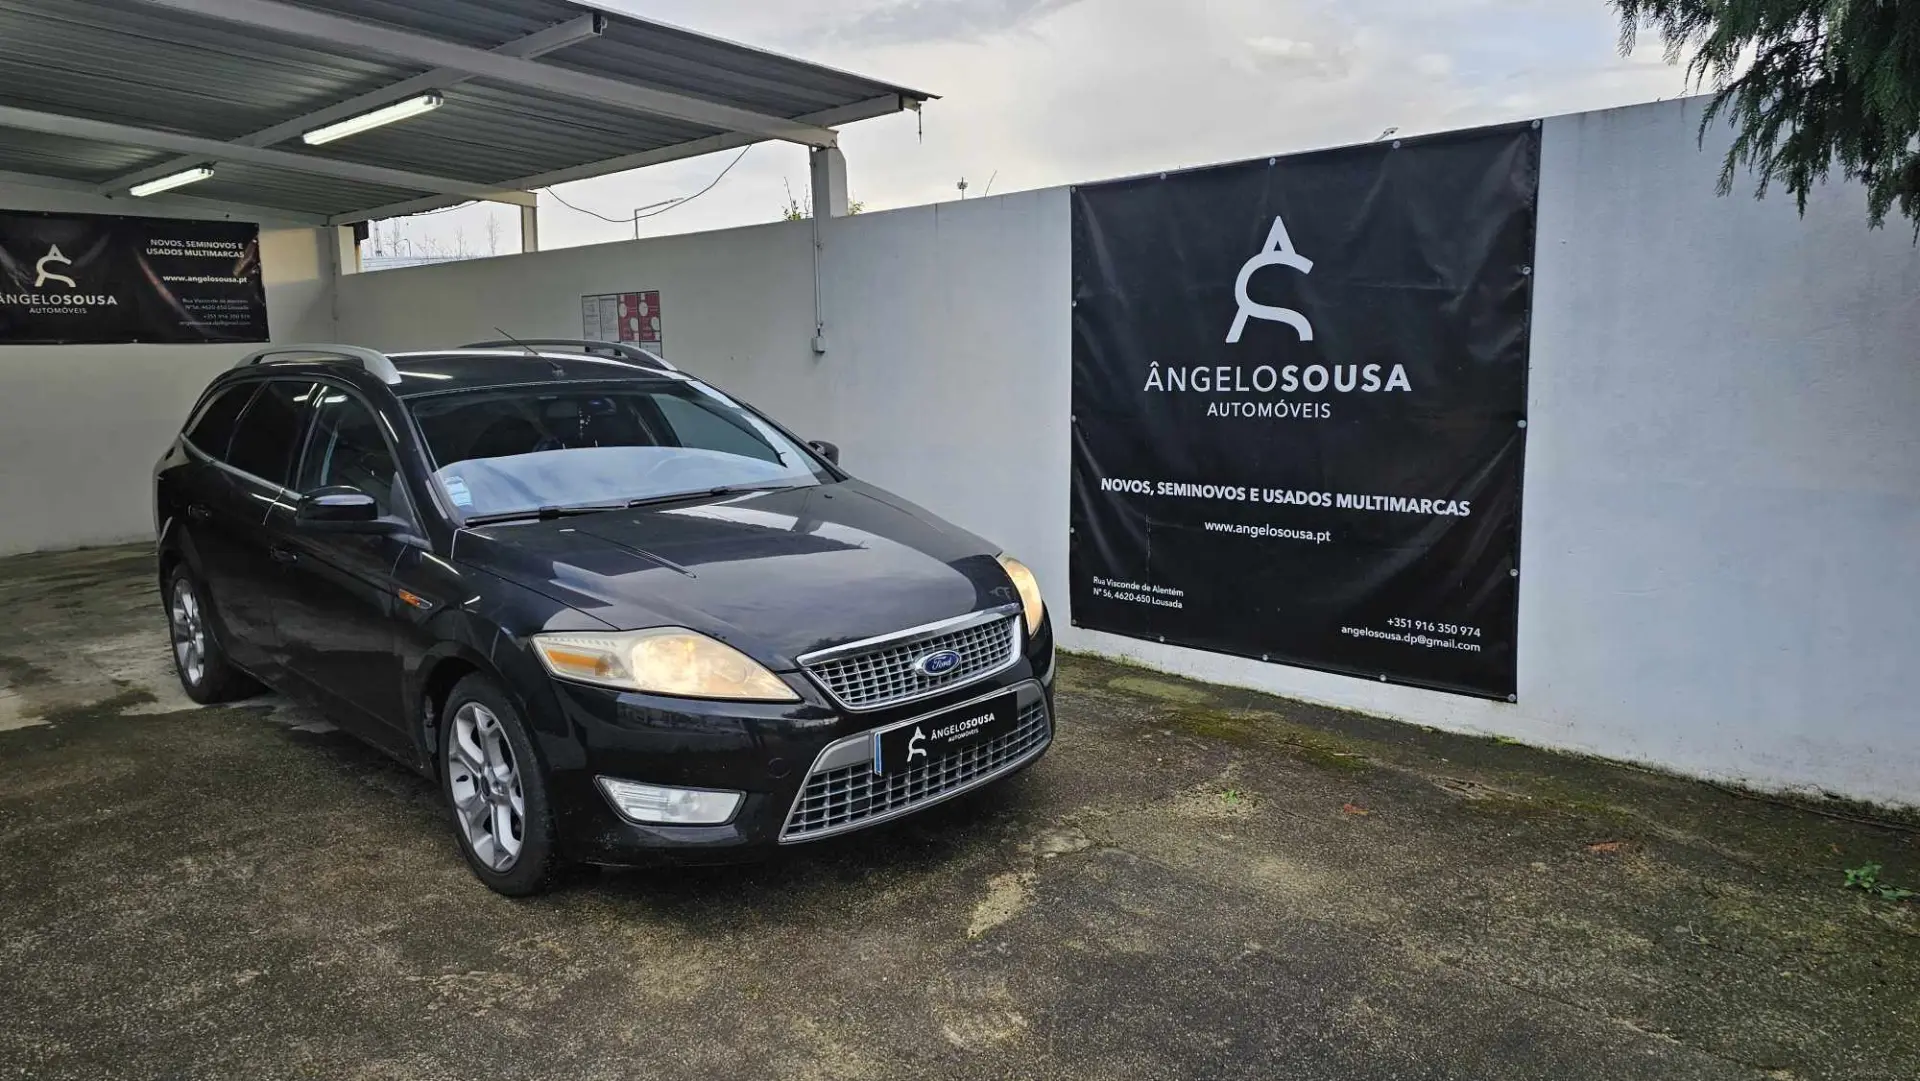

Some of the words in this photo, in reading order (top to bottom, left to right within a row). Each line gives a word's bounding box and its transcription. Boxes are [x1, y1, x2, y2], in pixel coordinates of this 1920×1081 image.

[146, 248, 183, 256] USADOS
[184, 249, 245, 258] MULTIMARCAS
[150, 239, 185, 248] NOVOS,
[186, 241, 237, 249] SEMINOVOS
[163, 275, 247, 284] www.angelosousa.pt
[29, 306, 88, 314] AUTOMÓVEIS
[1144, 361, 1412, 393] ÂNGELOSOUSA
[1207, 399, 1331, 418] AUTOMÓVEIS
[1101, 478, 1154, 496] NOVOS,
[1157, 482, 1246, 500] SEMINOVOS
[1250, 488, 1259, 501] E
[1263, 489, 1332, 507] USADOS
[1336, 493, 1471, 517] MULTIMARCAS
[1204, 521, 1331, 544] www.angelosousa.pt
[1093, 576, 1106, 585] Rua
[1106, 579, 1140, 590] Visconde
[1141, 583, 1151, 592] de
[1103, 590, 1114, 599] 56,
[1114, 593, 1151, 604] 4620-650
[1152, 597, 1183, 609] Lousada
[1387, 617, 1412, 629] +351
[1415, 620, 1435, 632] 916
[1437, 623, 1457, 635] 350
[1460, 626, 1481, 638] 974
[1341, 625, 1481, 652] angelosousa.dp@gmail.com
[931, 656, 952, 670] Ford
